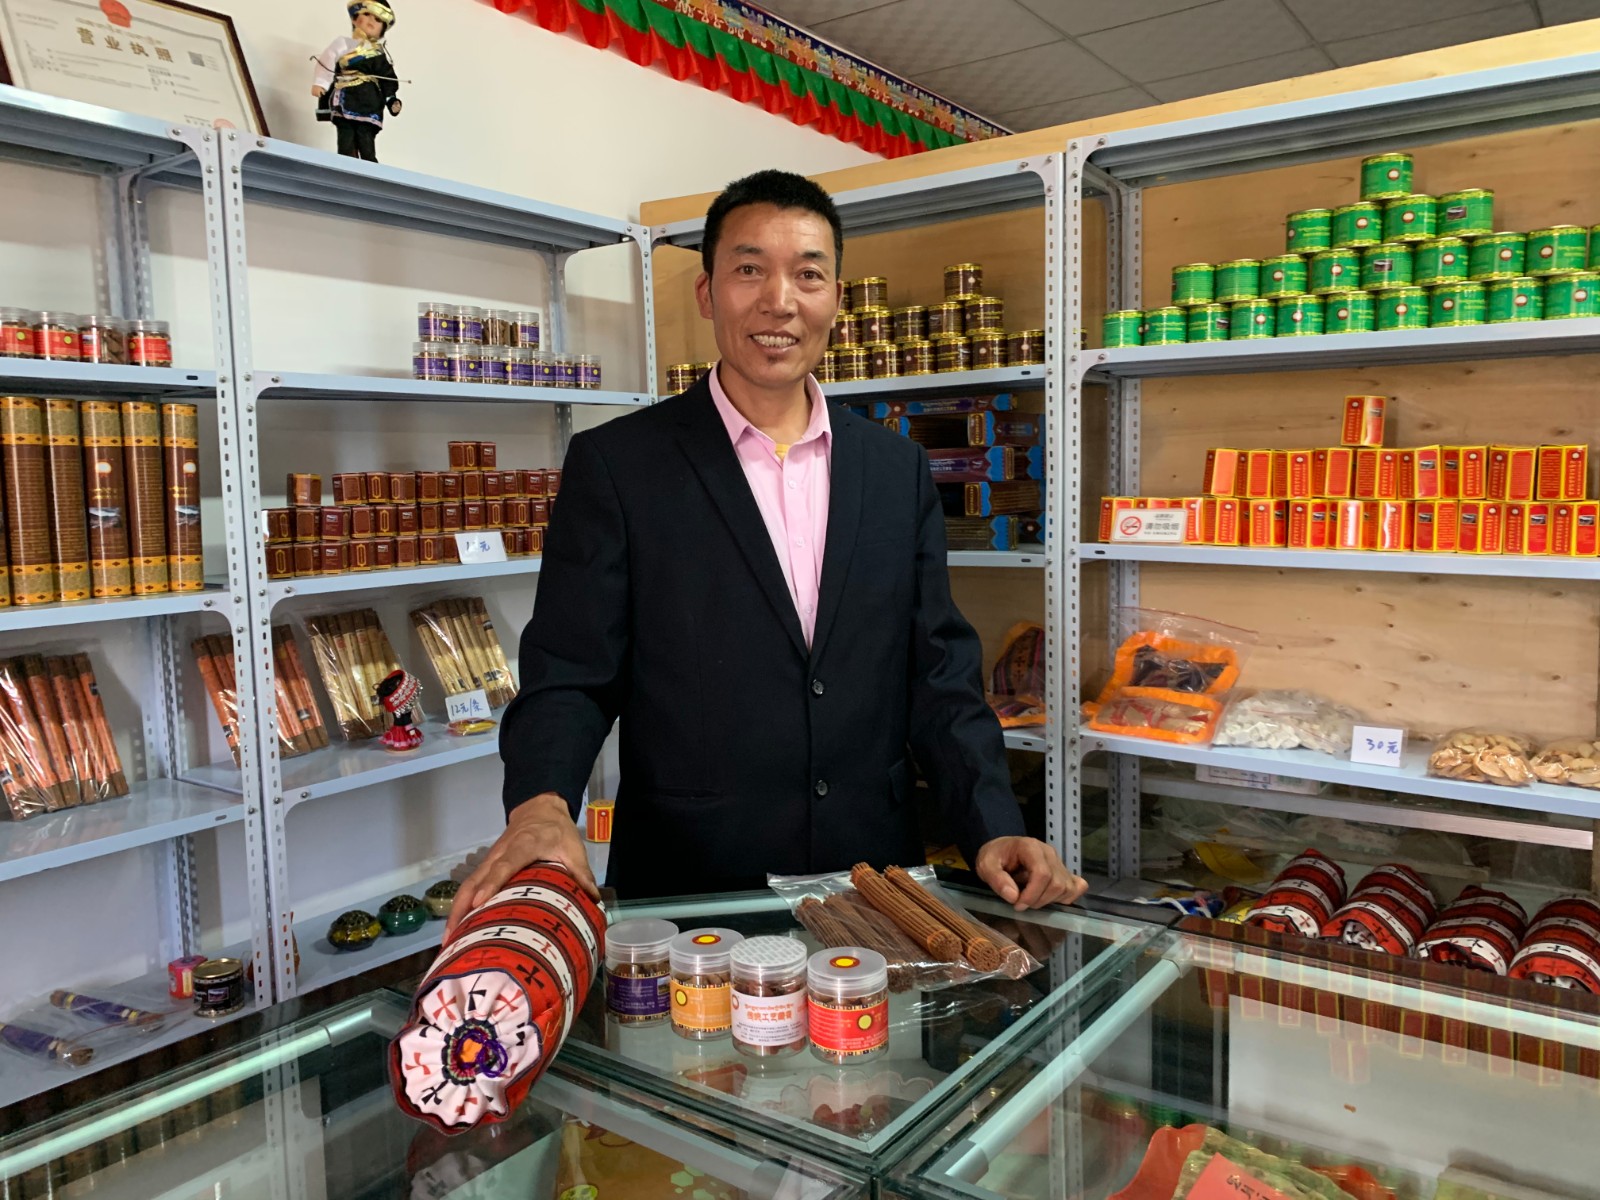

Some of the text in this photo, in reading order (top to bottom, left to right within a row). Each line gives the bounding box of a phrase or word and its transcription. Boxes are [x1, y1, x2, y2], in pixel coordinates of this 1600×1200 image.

[77, 27, 175, 63] 营业执照
[466, 541, 491, 552] 1元
[451, 698, 483, 717] 12元/条
[1365, 738, 1399, 754] 30元
